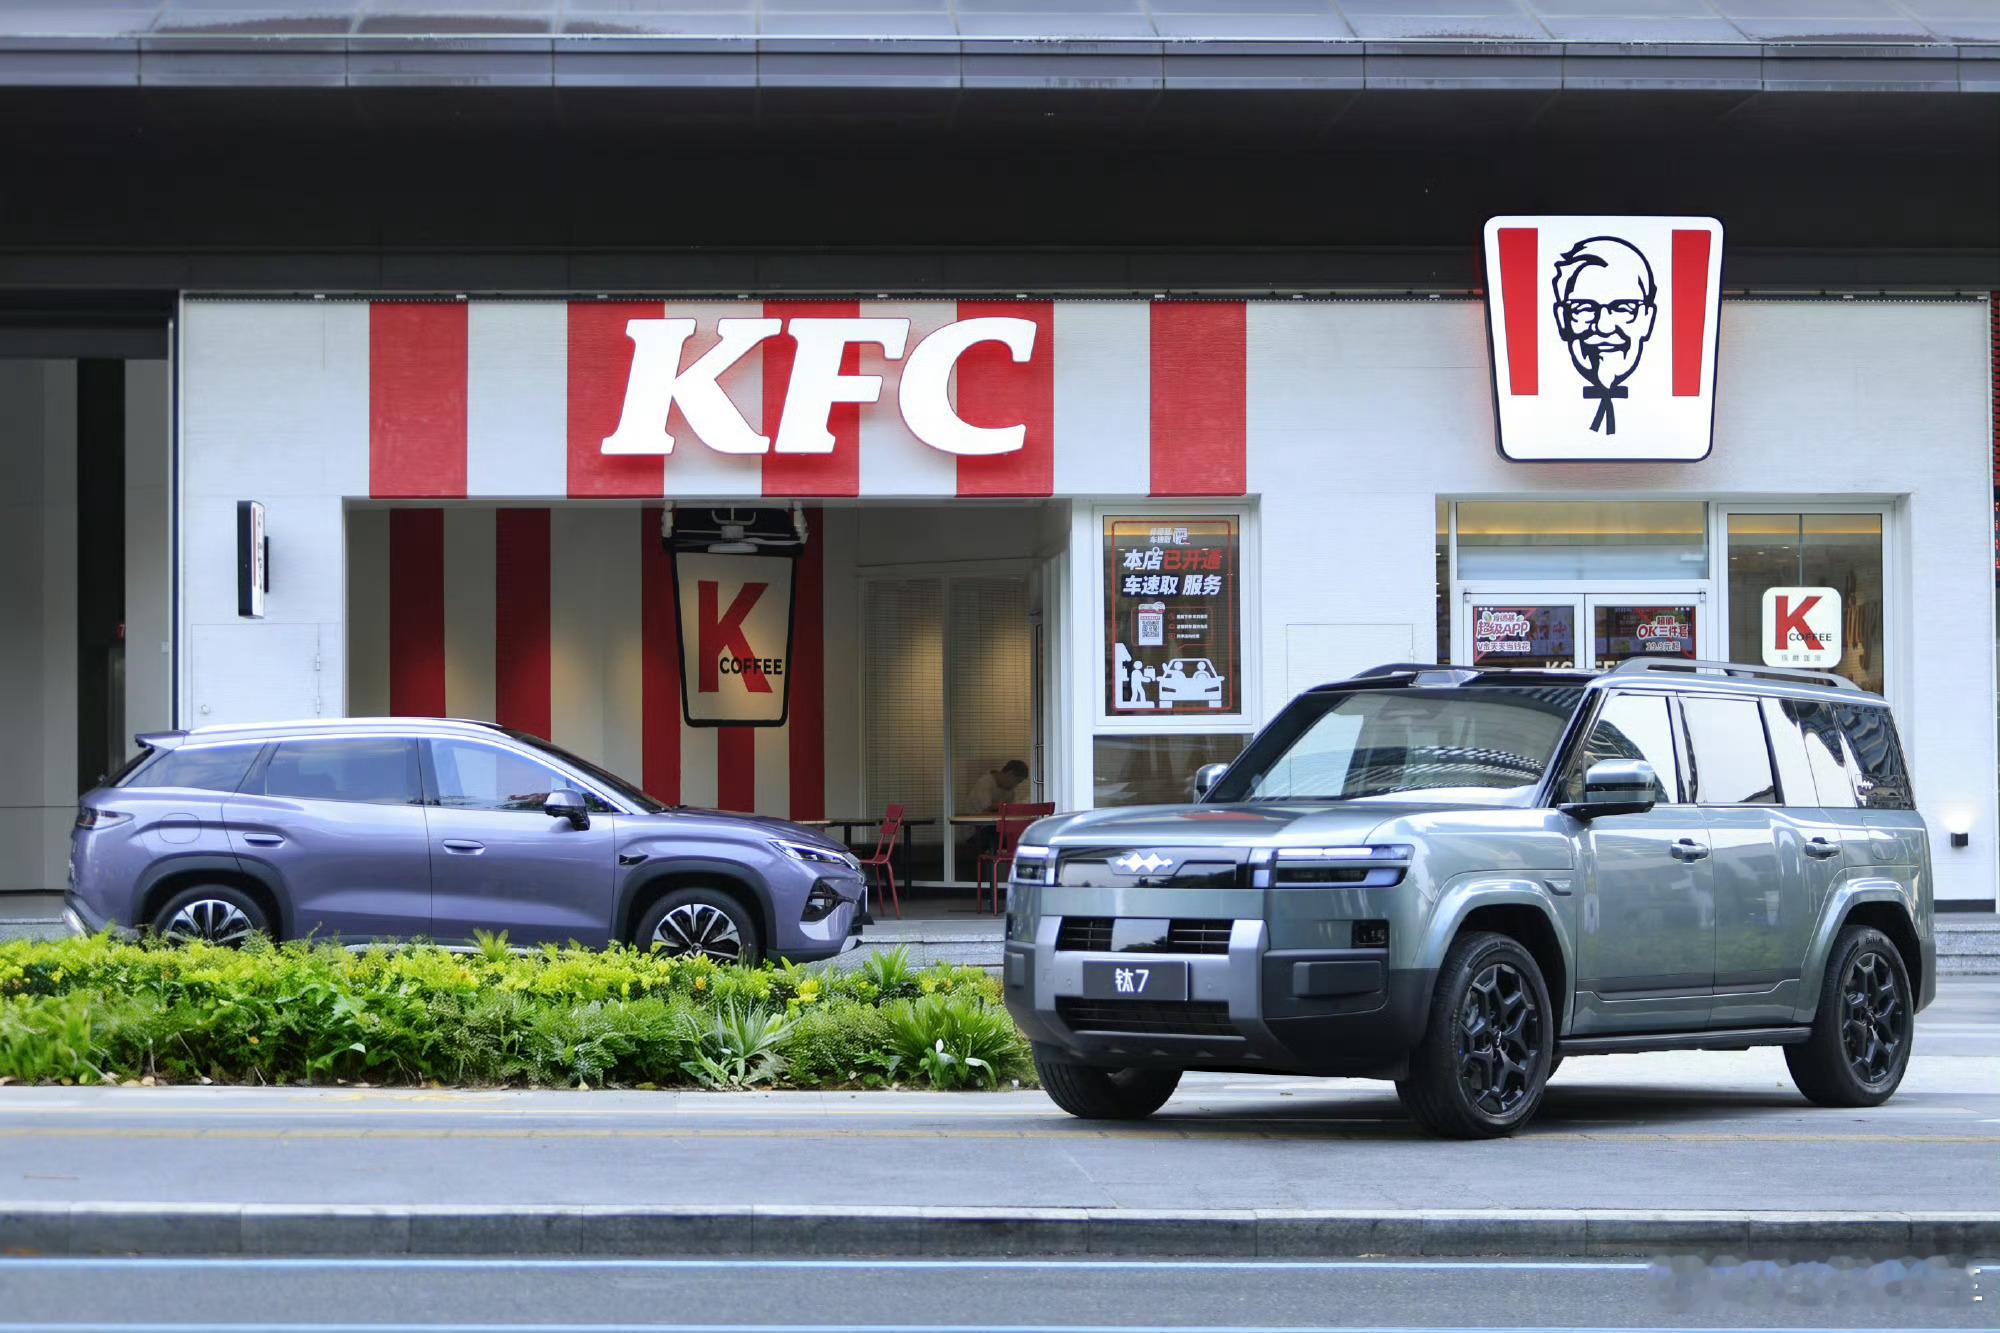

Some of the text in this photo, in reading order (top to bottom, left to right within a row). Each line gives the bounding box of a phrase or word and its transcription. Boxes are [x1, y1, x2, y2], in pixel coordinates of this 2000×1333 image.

[600, 317, 1037, 455] KFC
[1123, 547, 1222, 570] 本店已开通
[1122, 574, 1222, 595] 车速取 服务
[1476, 621, 1530, 638] 超级APP
[1775, 596, 1832, 650] K COFFEE
[698, 580, 783, 693] K COFFEE
[1115, 968, 1149, 992] 钛7
